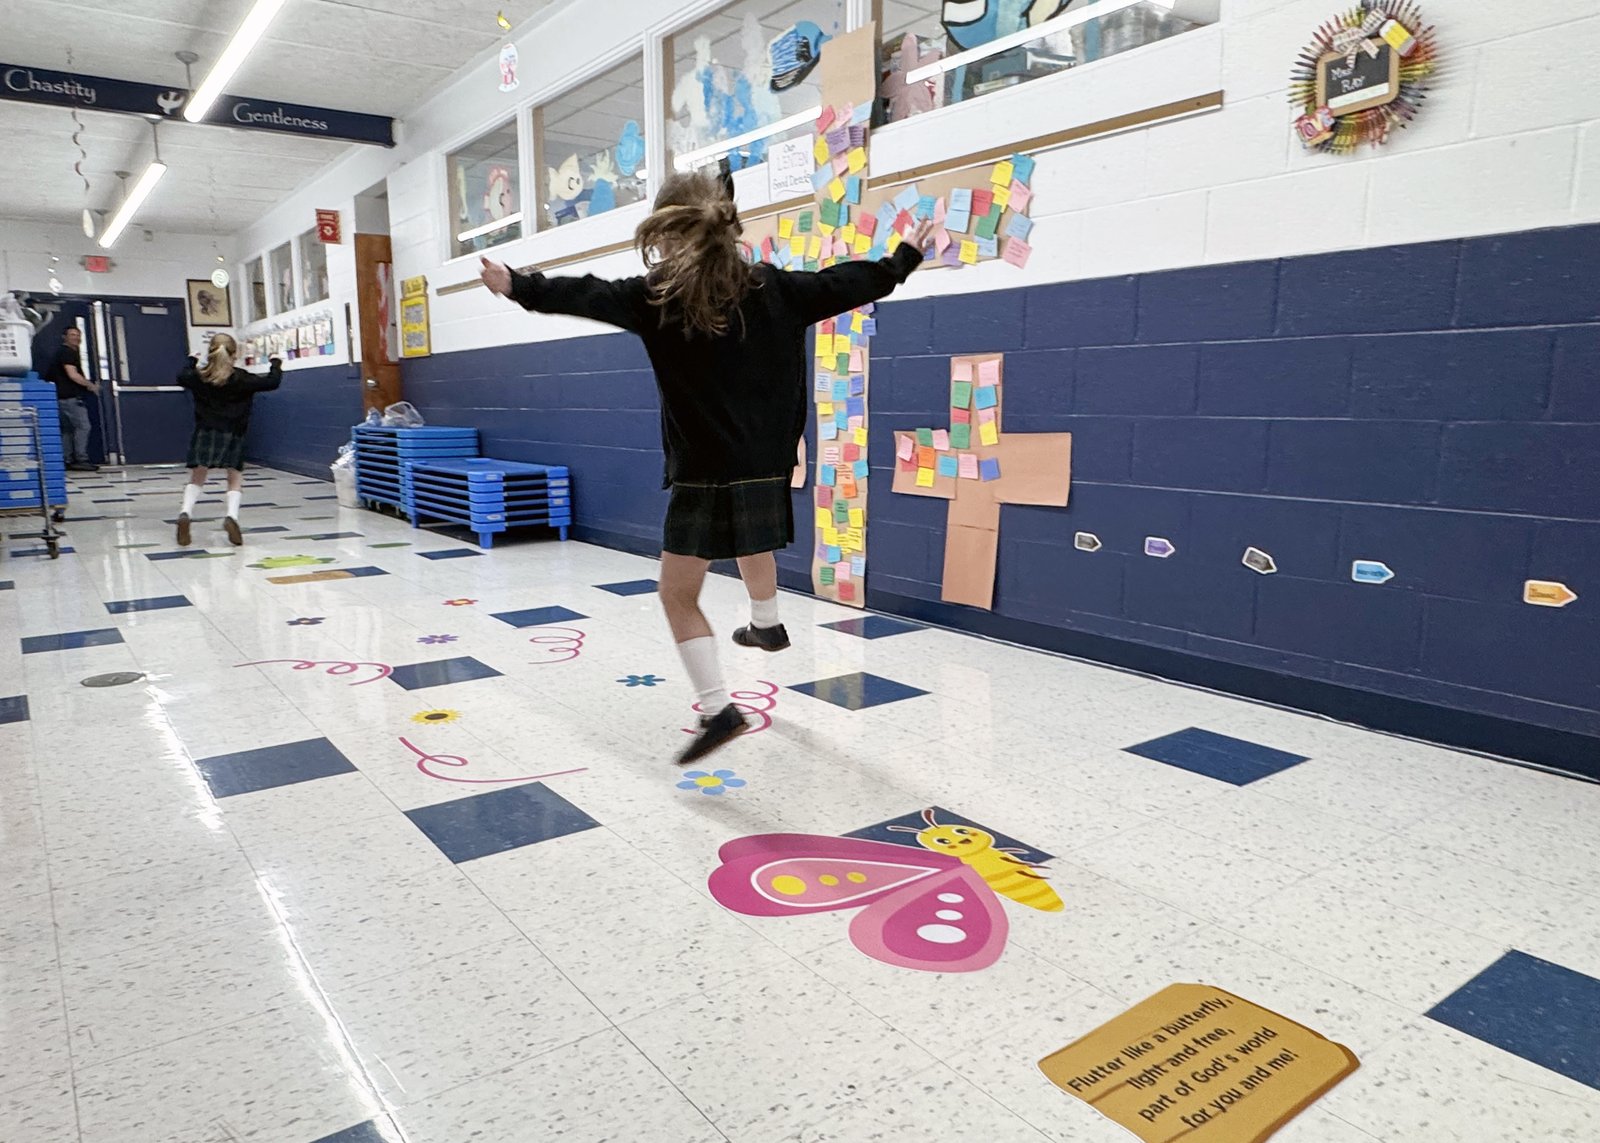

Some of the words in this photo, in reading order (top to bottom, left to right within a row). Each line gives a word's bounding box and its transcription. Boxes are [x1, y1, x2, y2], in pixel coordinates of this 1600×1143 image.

[4, 68, 97, 104] Chastity
[232, 102, 329, 131] Gentleness
[1066, 1056, 1126, 1093] Flutter
[1120, 1040, 1155, 1060] like
[1152, 1032, 1168, 1043] a
[1161, 997, 1234, 1036] butterfly,
[1125, 1063, 1169, 1091] light
[1166, 1043, 1199, 1067] and
[1192, 1026, 1236, 1049] free,
[1138, 1093, 1177, 1123] part
[1174, 1079, 1196, 1097] of
[1191, 1053, 1240, 1084] God's
[1235, 1025, 1279, 1055] world
[1180, 1107, 1213, 1129] for
[1209, 1087, 1244, 1113] you
[1239, 1065, 1272, 1091] and
[1266, 1047, 1300, 1071] me!
